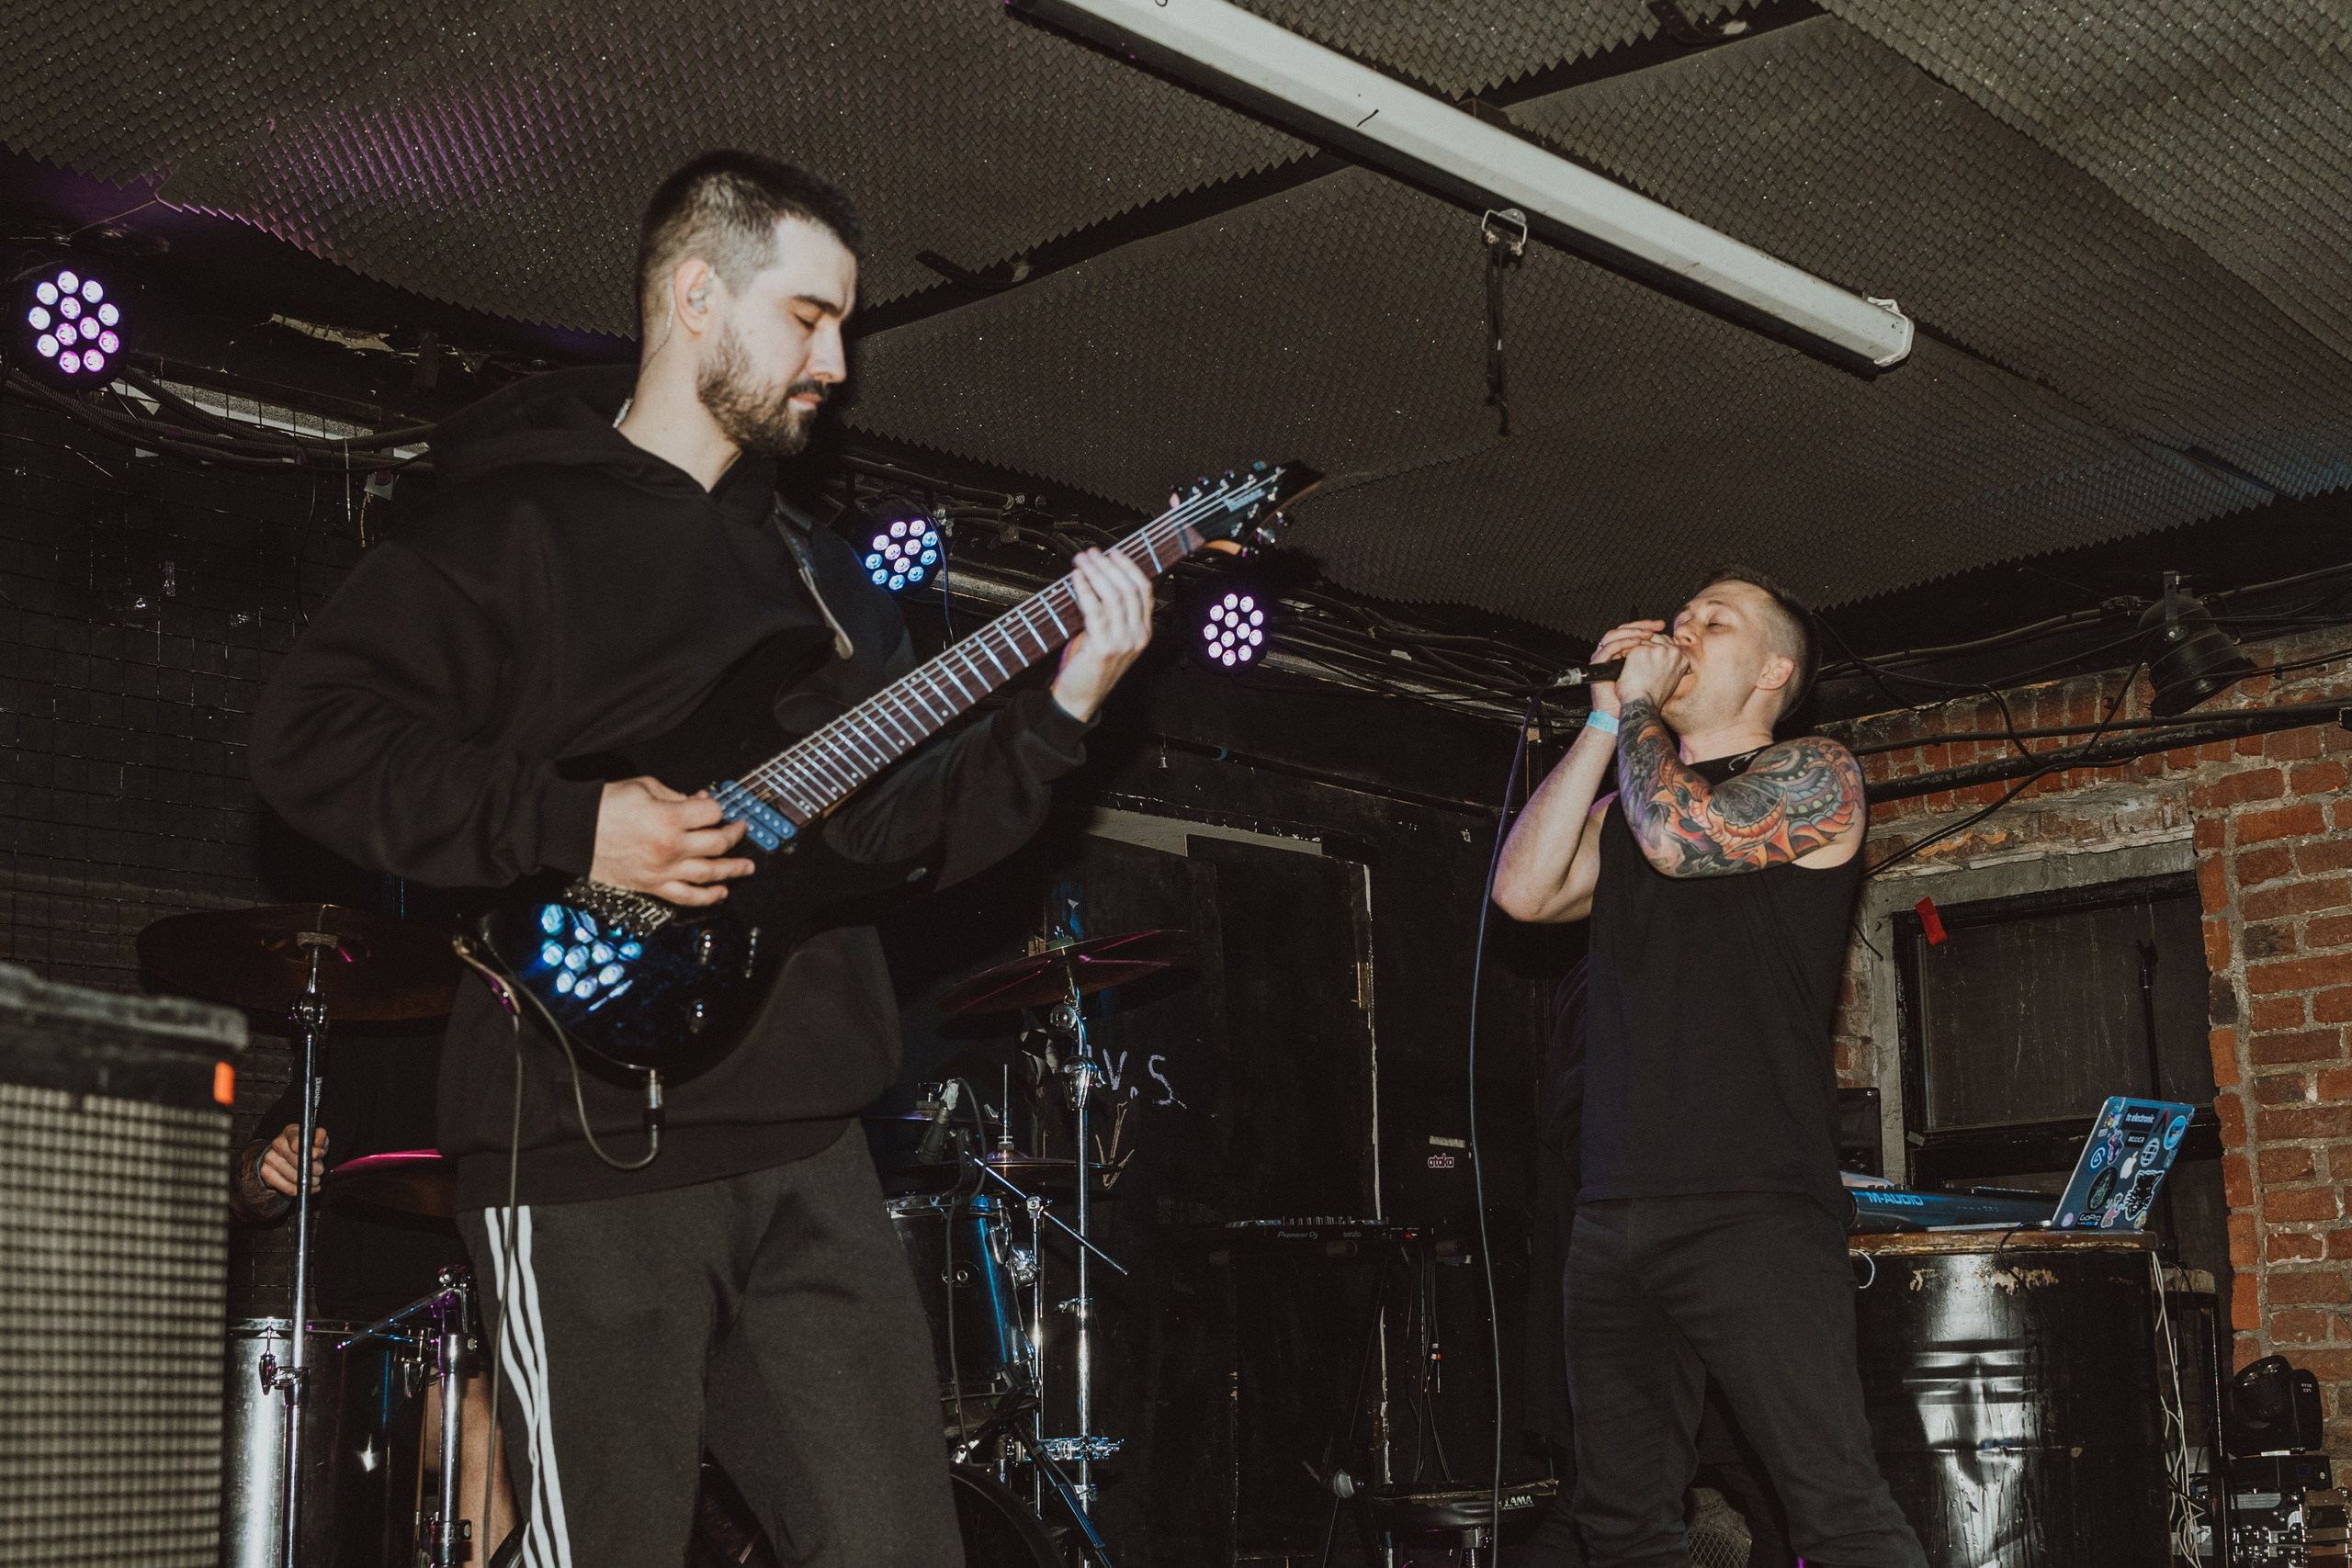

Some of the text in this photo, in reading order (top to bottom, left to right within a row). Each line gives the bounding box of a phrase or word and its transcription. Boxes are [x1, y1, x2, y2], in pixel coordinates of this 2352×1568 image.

[1428, 1153, 1454, 1168] ataka
[1865, 1191, 1924, 1206] M-AUDIO
[2079, 1213, 2102, 1222] GoPro
